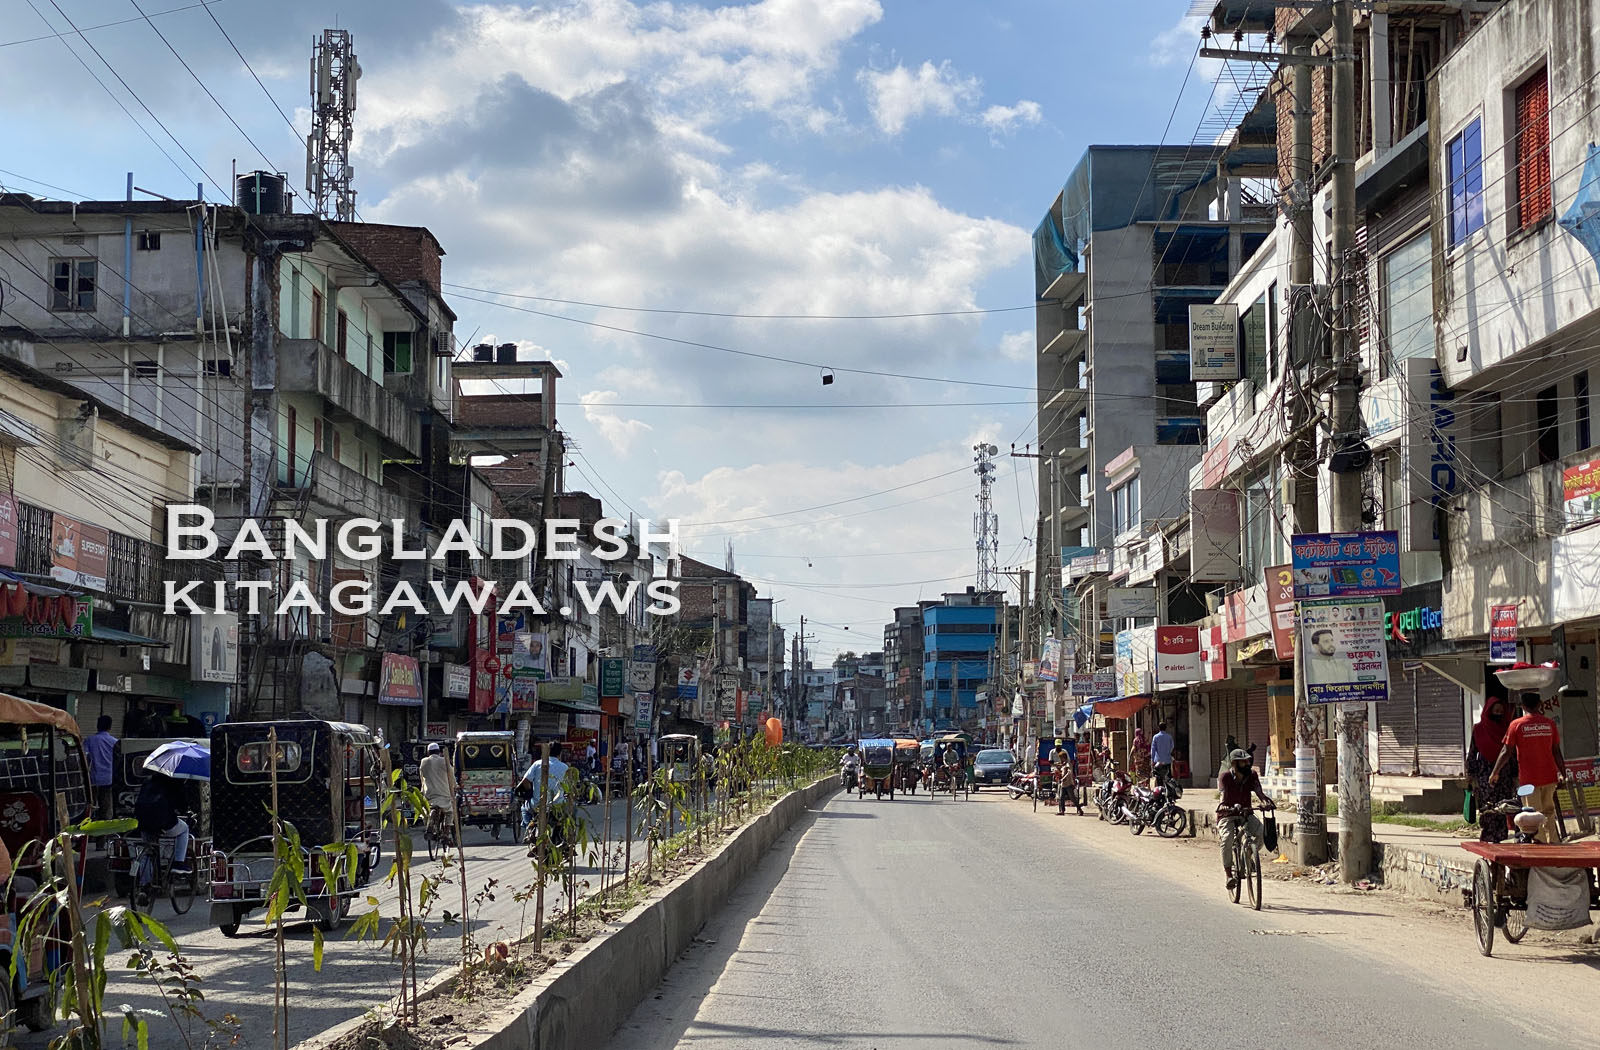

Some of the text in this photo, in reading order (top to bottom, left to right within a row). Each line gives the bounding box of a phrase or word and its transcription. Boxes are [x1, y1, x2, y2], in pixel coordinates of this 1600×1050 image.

[1193, 322, 1234, 332] Dream Building
[1421, 606, 1443, 630] Elec
[1172, 635, 1184, 644] রবি
